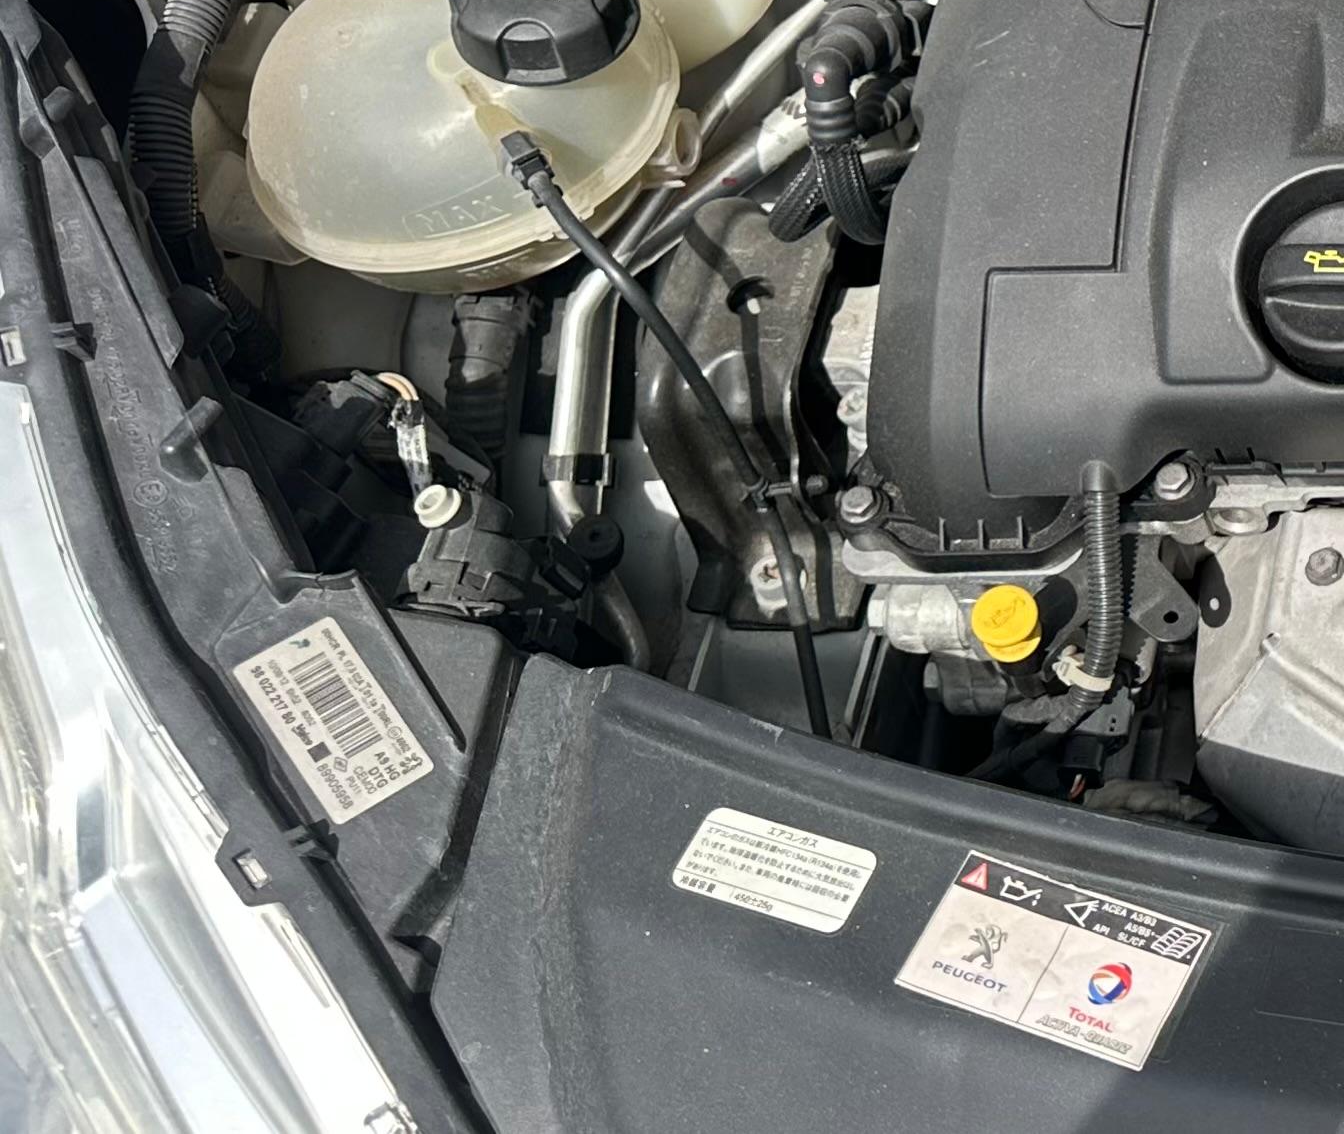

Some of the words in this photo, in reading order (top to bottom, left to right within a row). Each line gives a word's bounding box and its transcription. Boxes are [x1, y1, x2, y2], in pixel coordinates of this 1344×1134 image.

[414, 194, 505, 233] MAX
[250, 665, 264, 678] 98
[258, 677, 276, 695] 022
[269, 693, 288, 712] 217
[281, 710, 296, 724] 80
[368, 766, 387, 788] DTG
[374, 750, 389, 765] A9
[384, 764, 400, 781] HG
[1100, 901, 1129, 917] ACEA
[1129, 910, 1158, 927] A3/B3
[1090, 922, 1111, 936] API
[1115, 930, 1147, 948] SL/CF
[930, 958, 1008, 995] PEUGEOT
[1065, 1005, 1118, 1034] TOTAL
